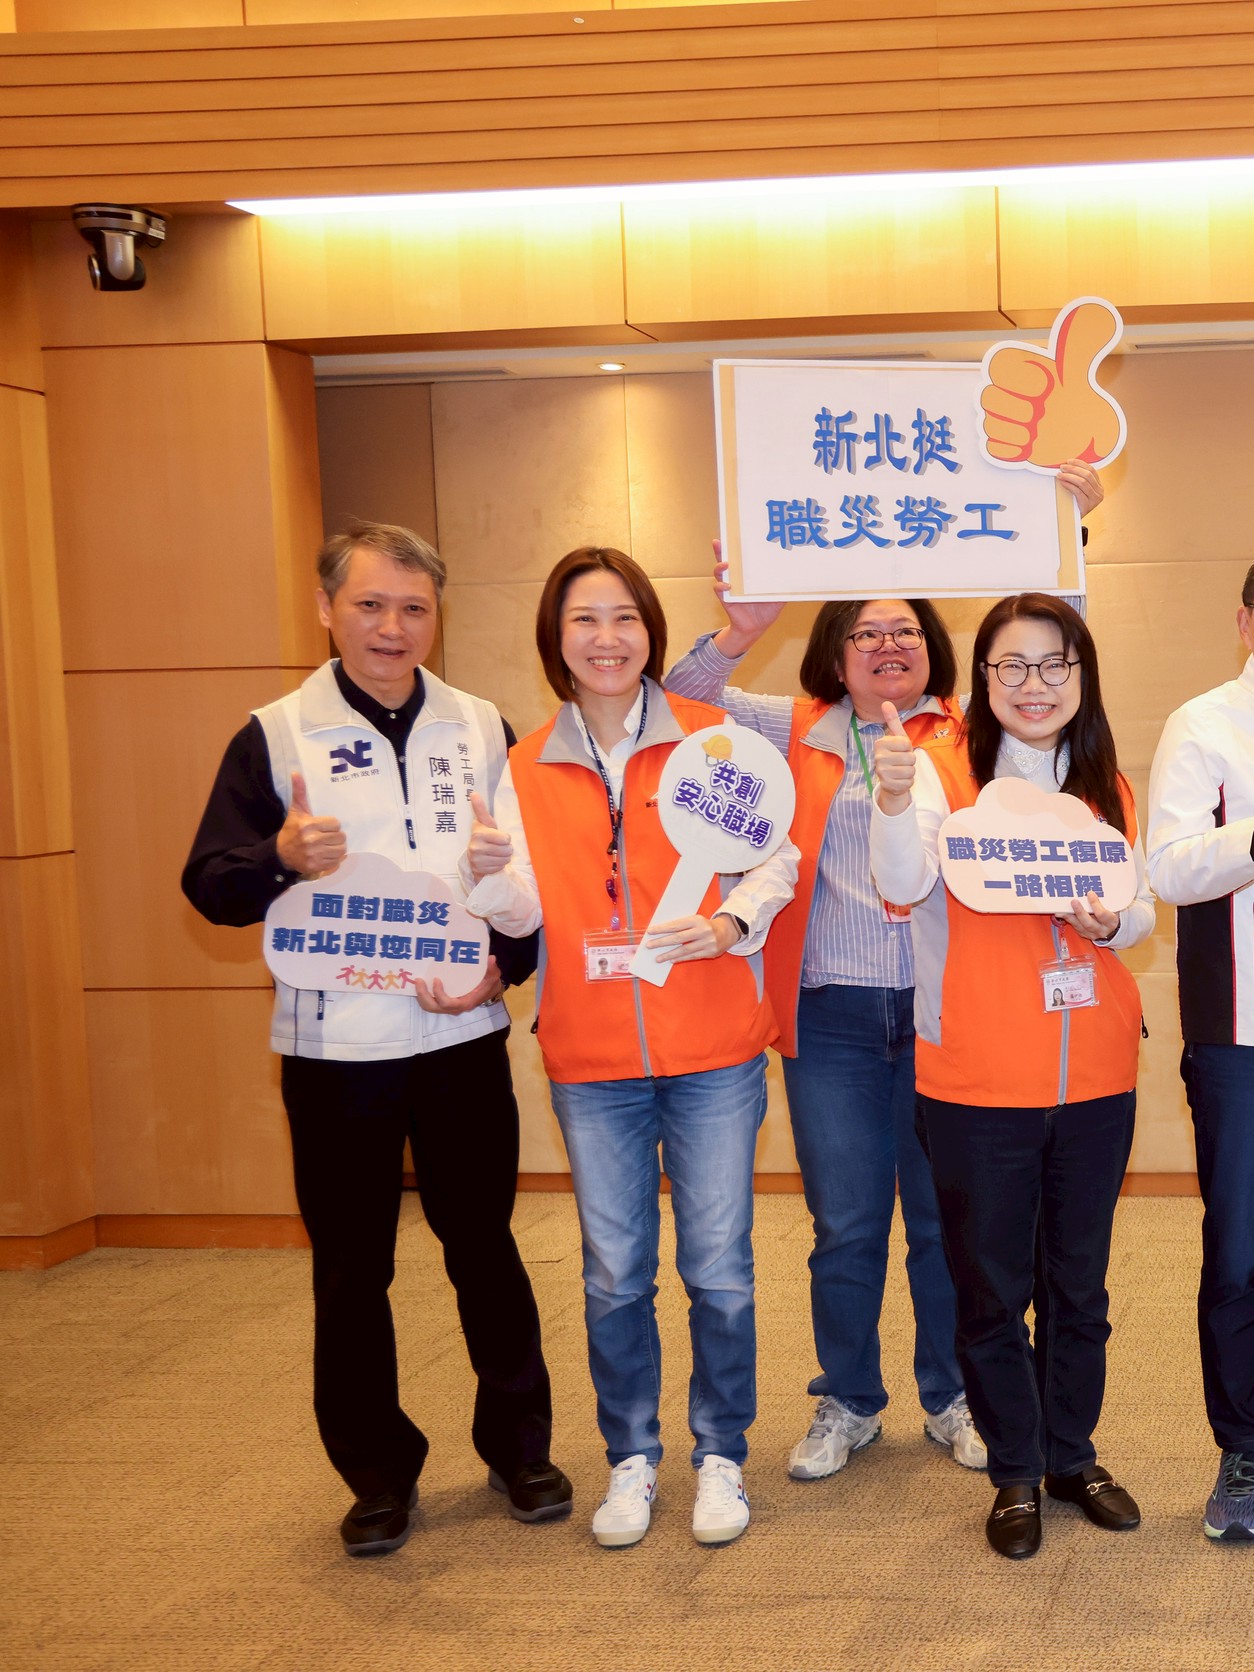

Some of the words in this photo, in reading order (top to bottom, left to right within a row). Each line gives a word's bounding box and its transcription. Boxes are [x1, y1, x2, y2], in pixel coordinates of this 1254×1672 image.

[813, 407, 960, 475] 新北挺
[766, 494, 1016, 550] 職災勞工
[330, 768, 380, 783] 新北市政府
[428, 757, 457, 833] 陳瑞嘉
[711, 761, 765, 807] 共創
[674, 778, 772, 848] 安心職場
[945, 836, 1129, 864] 職災勞工復原
[984, 874, 1105, 898] 一路相挺
[311, 893, 450, 927] 面對職災
[272, 927, 481, 965] 新北與您同在
